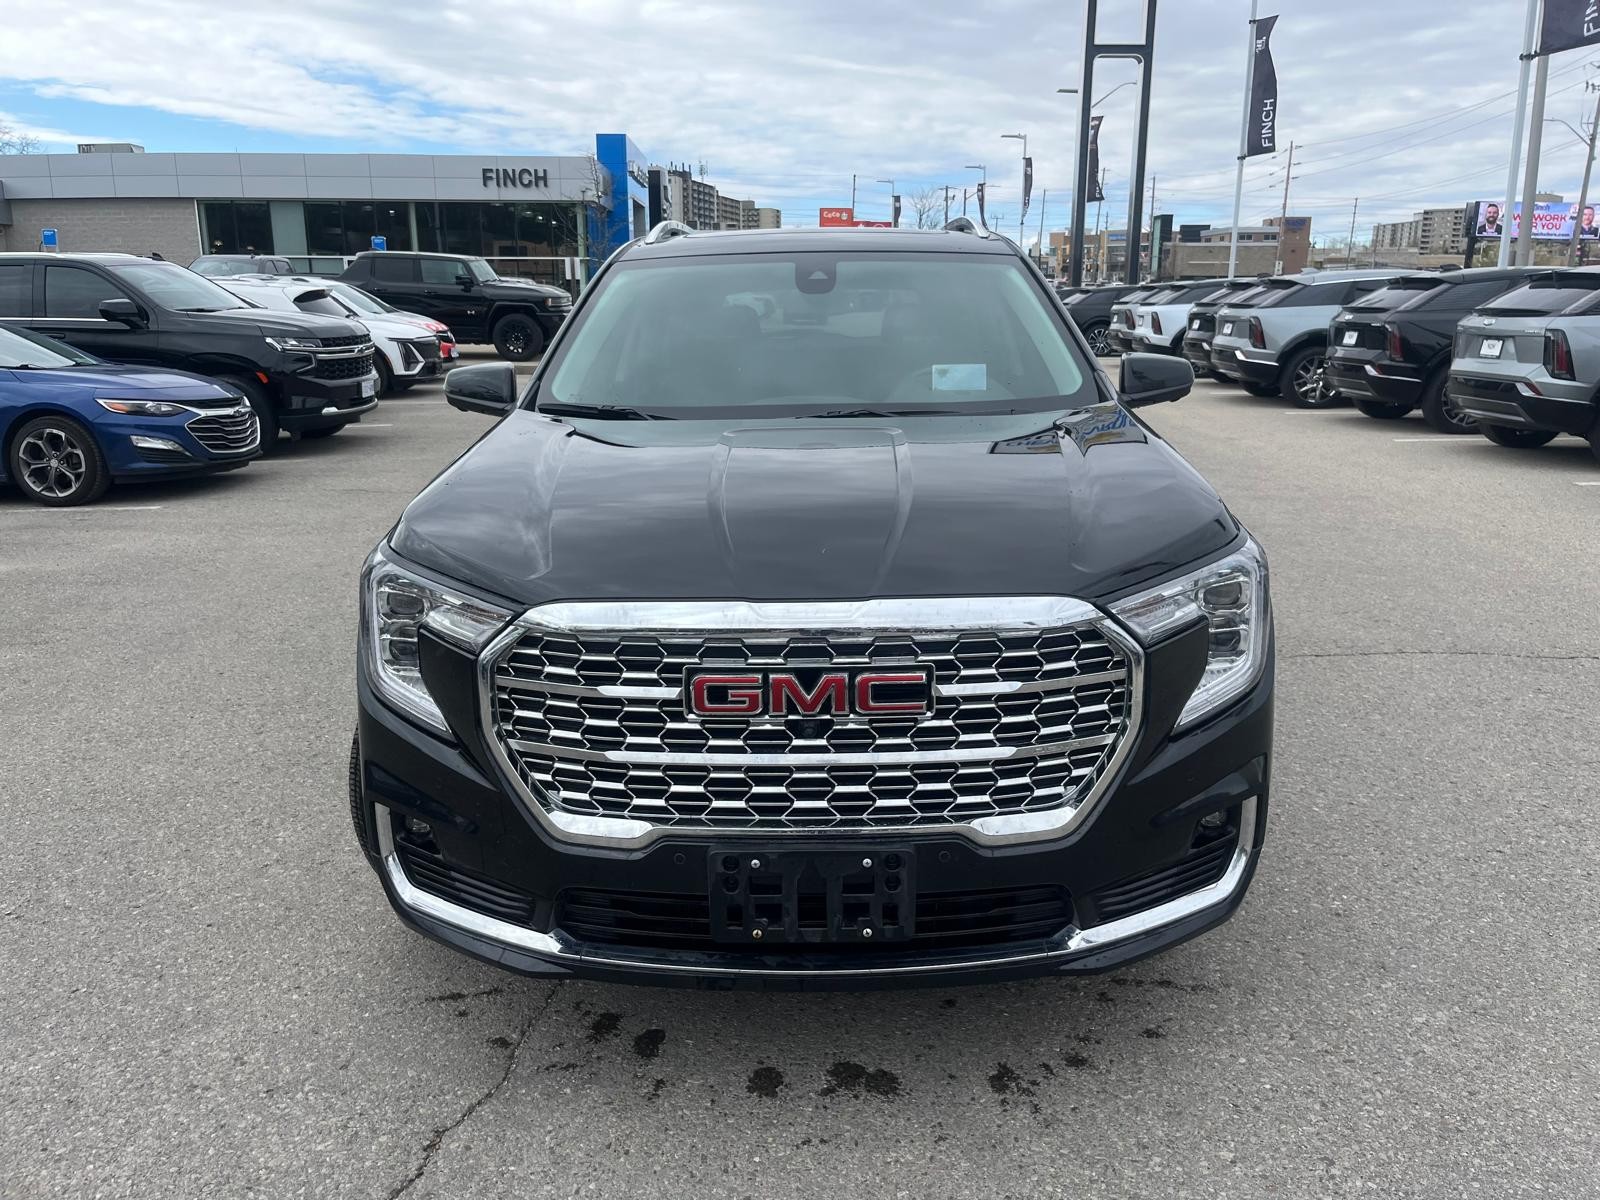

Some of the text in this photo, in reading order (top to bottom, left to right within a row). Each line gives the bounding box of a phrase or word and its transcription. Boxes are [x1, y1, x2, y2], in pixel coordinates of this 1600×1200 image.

[1261, 98, 1275, 148] FINCH
[482, 168, 549, 189] FINCH
[1533, 213, 1568, 222] WORK
[1541, 222, 1562, 230] YOU
[690, 672, 928, 716] GMC
